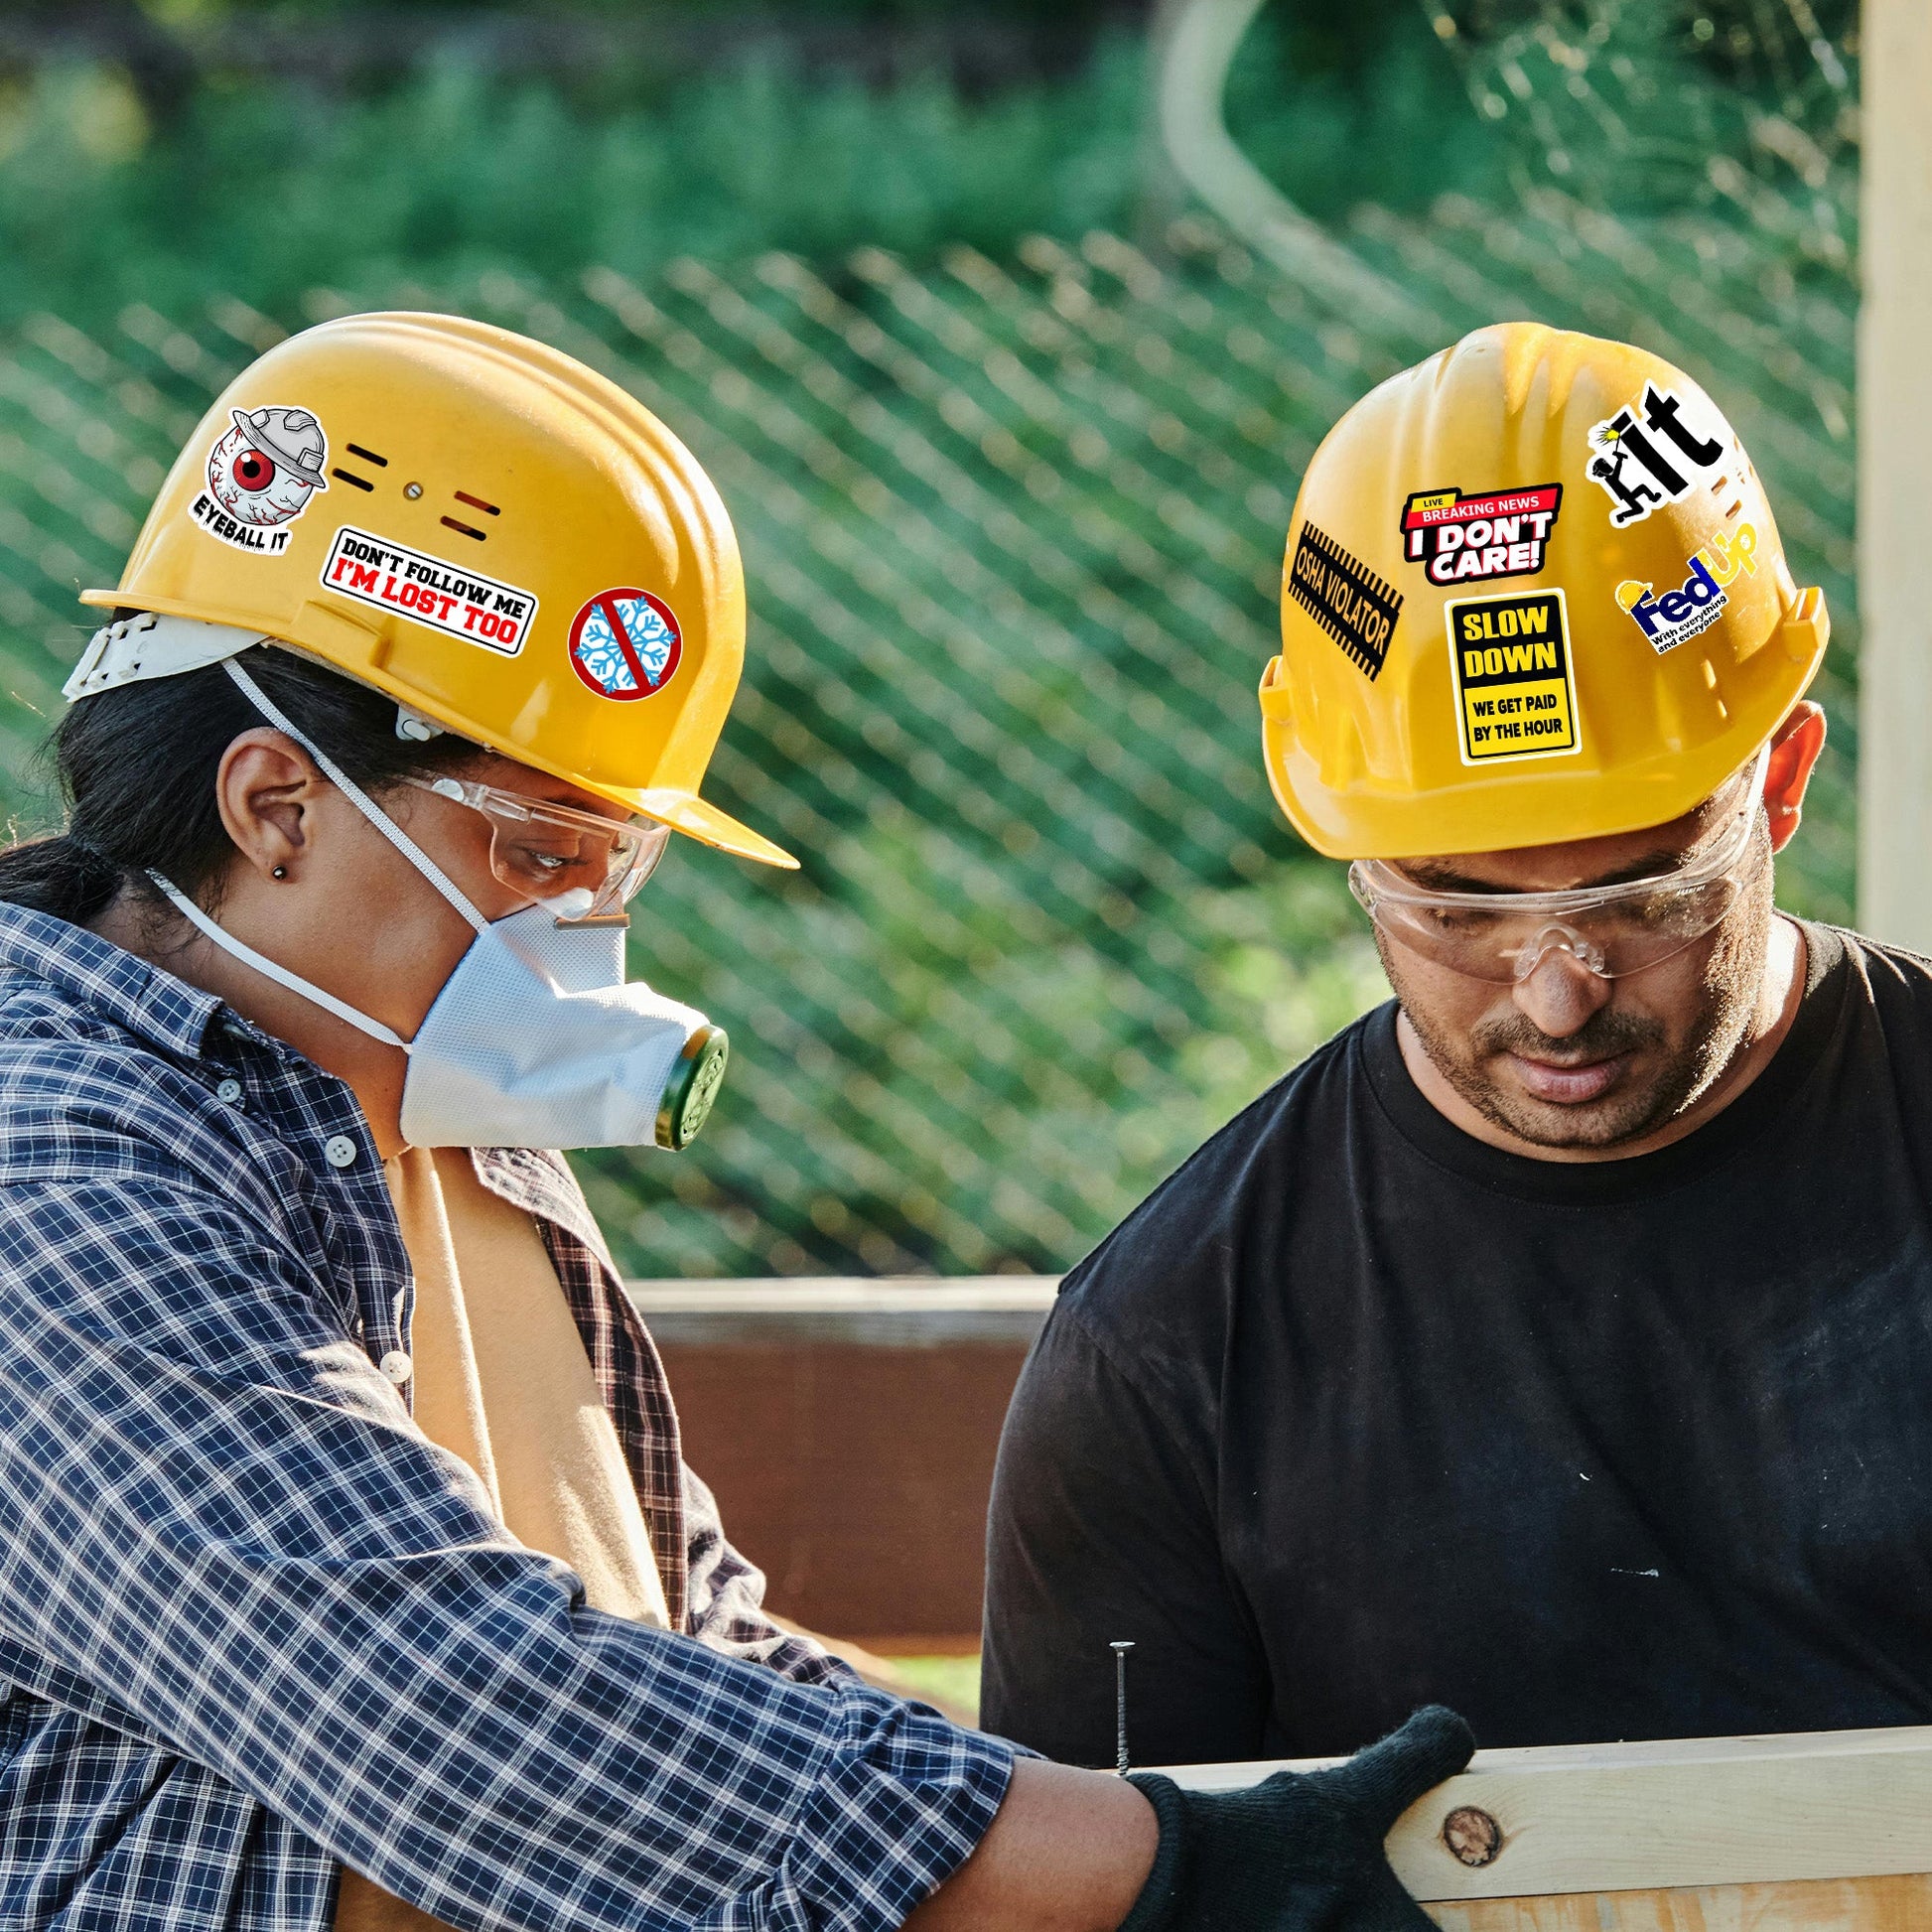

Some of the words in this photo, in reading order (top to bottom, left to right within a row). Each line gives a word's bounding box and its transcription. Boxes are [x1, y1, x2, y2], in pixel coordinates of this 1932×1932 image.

[1605, 386, 1724, 495] it
[194, 494, 265, 549] EYEBALL
[271, 532, 288, 549] IT
[1423, 502, 1494, 522] BREAKING
[1498, 496, 1539, 512] NEWS
[1424, 497, 1444, 507] LIVE
[1410, 529, 1424, 557] I
[1437, 511, 1553, 553] DON'T
[342, 537, 404, 573] DON'T
[404, 561, 492, 607] FOLLOW
[493, 595, 526, 620] ME
[1431, 540, 1541, 581] CARE!
[332, 557, 380, 593] I'M
[381, 575, 458, 621] LOST
[464, 604, 518, 644] TOO
[1296, 546, 1326, 596] OSHA
[1324, 570, 1390, 656] VIOLATOR
[1651, 628, 1678, 646] With
[1679, 596, 1727, 632] everything
[1462, 606, 1549, 641] SLOW
[1658, 638, 1678, 653] and
[1679, 612, 1721, 642] everyone
[1463, 641, 1558, 678] DOWN
[1472, 701, 1494, 717] WE
[1497, 697, 1523, 715] GET
[1526, 694, 1558, 712] PAID
[1473, 726, 1491, 743] BY
[1494, 721, 1522, 741] THE
[1524, 718, 1564, 737] HOUR
